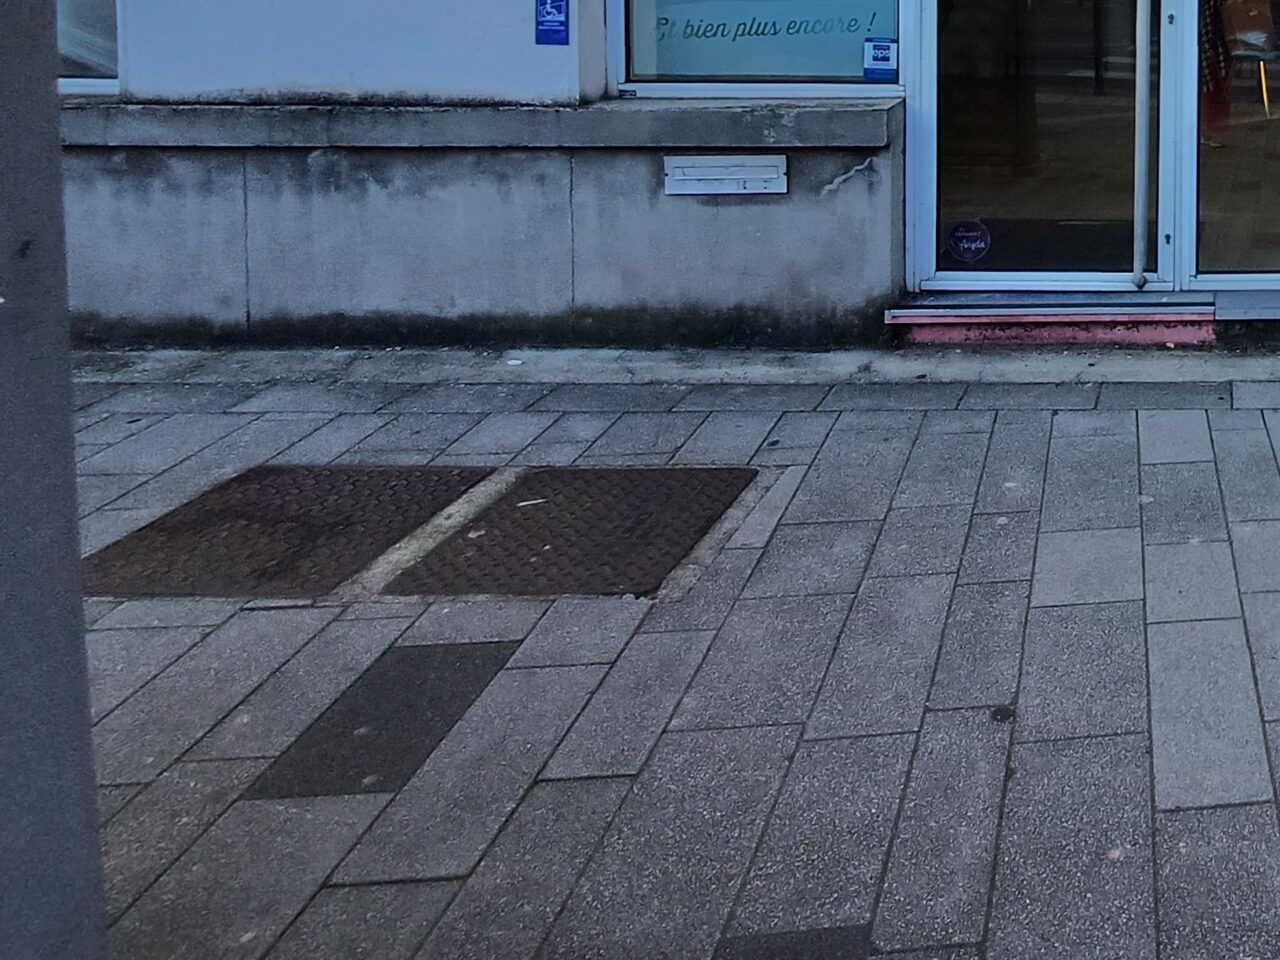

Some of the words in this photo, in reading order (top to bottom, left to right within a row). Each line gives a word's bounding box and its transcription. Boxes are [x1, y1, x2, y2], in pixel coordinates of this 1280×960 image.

[682, 18, 732, 39] bien
[732, 16, 781, 42] plus
[786, 17, 861, 36] encore
